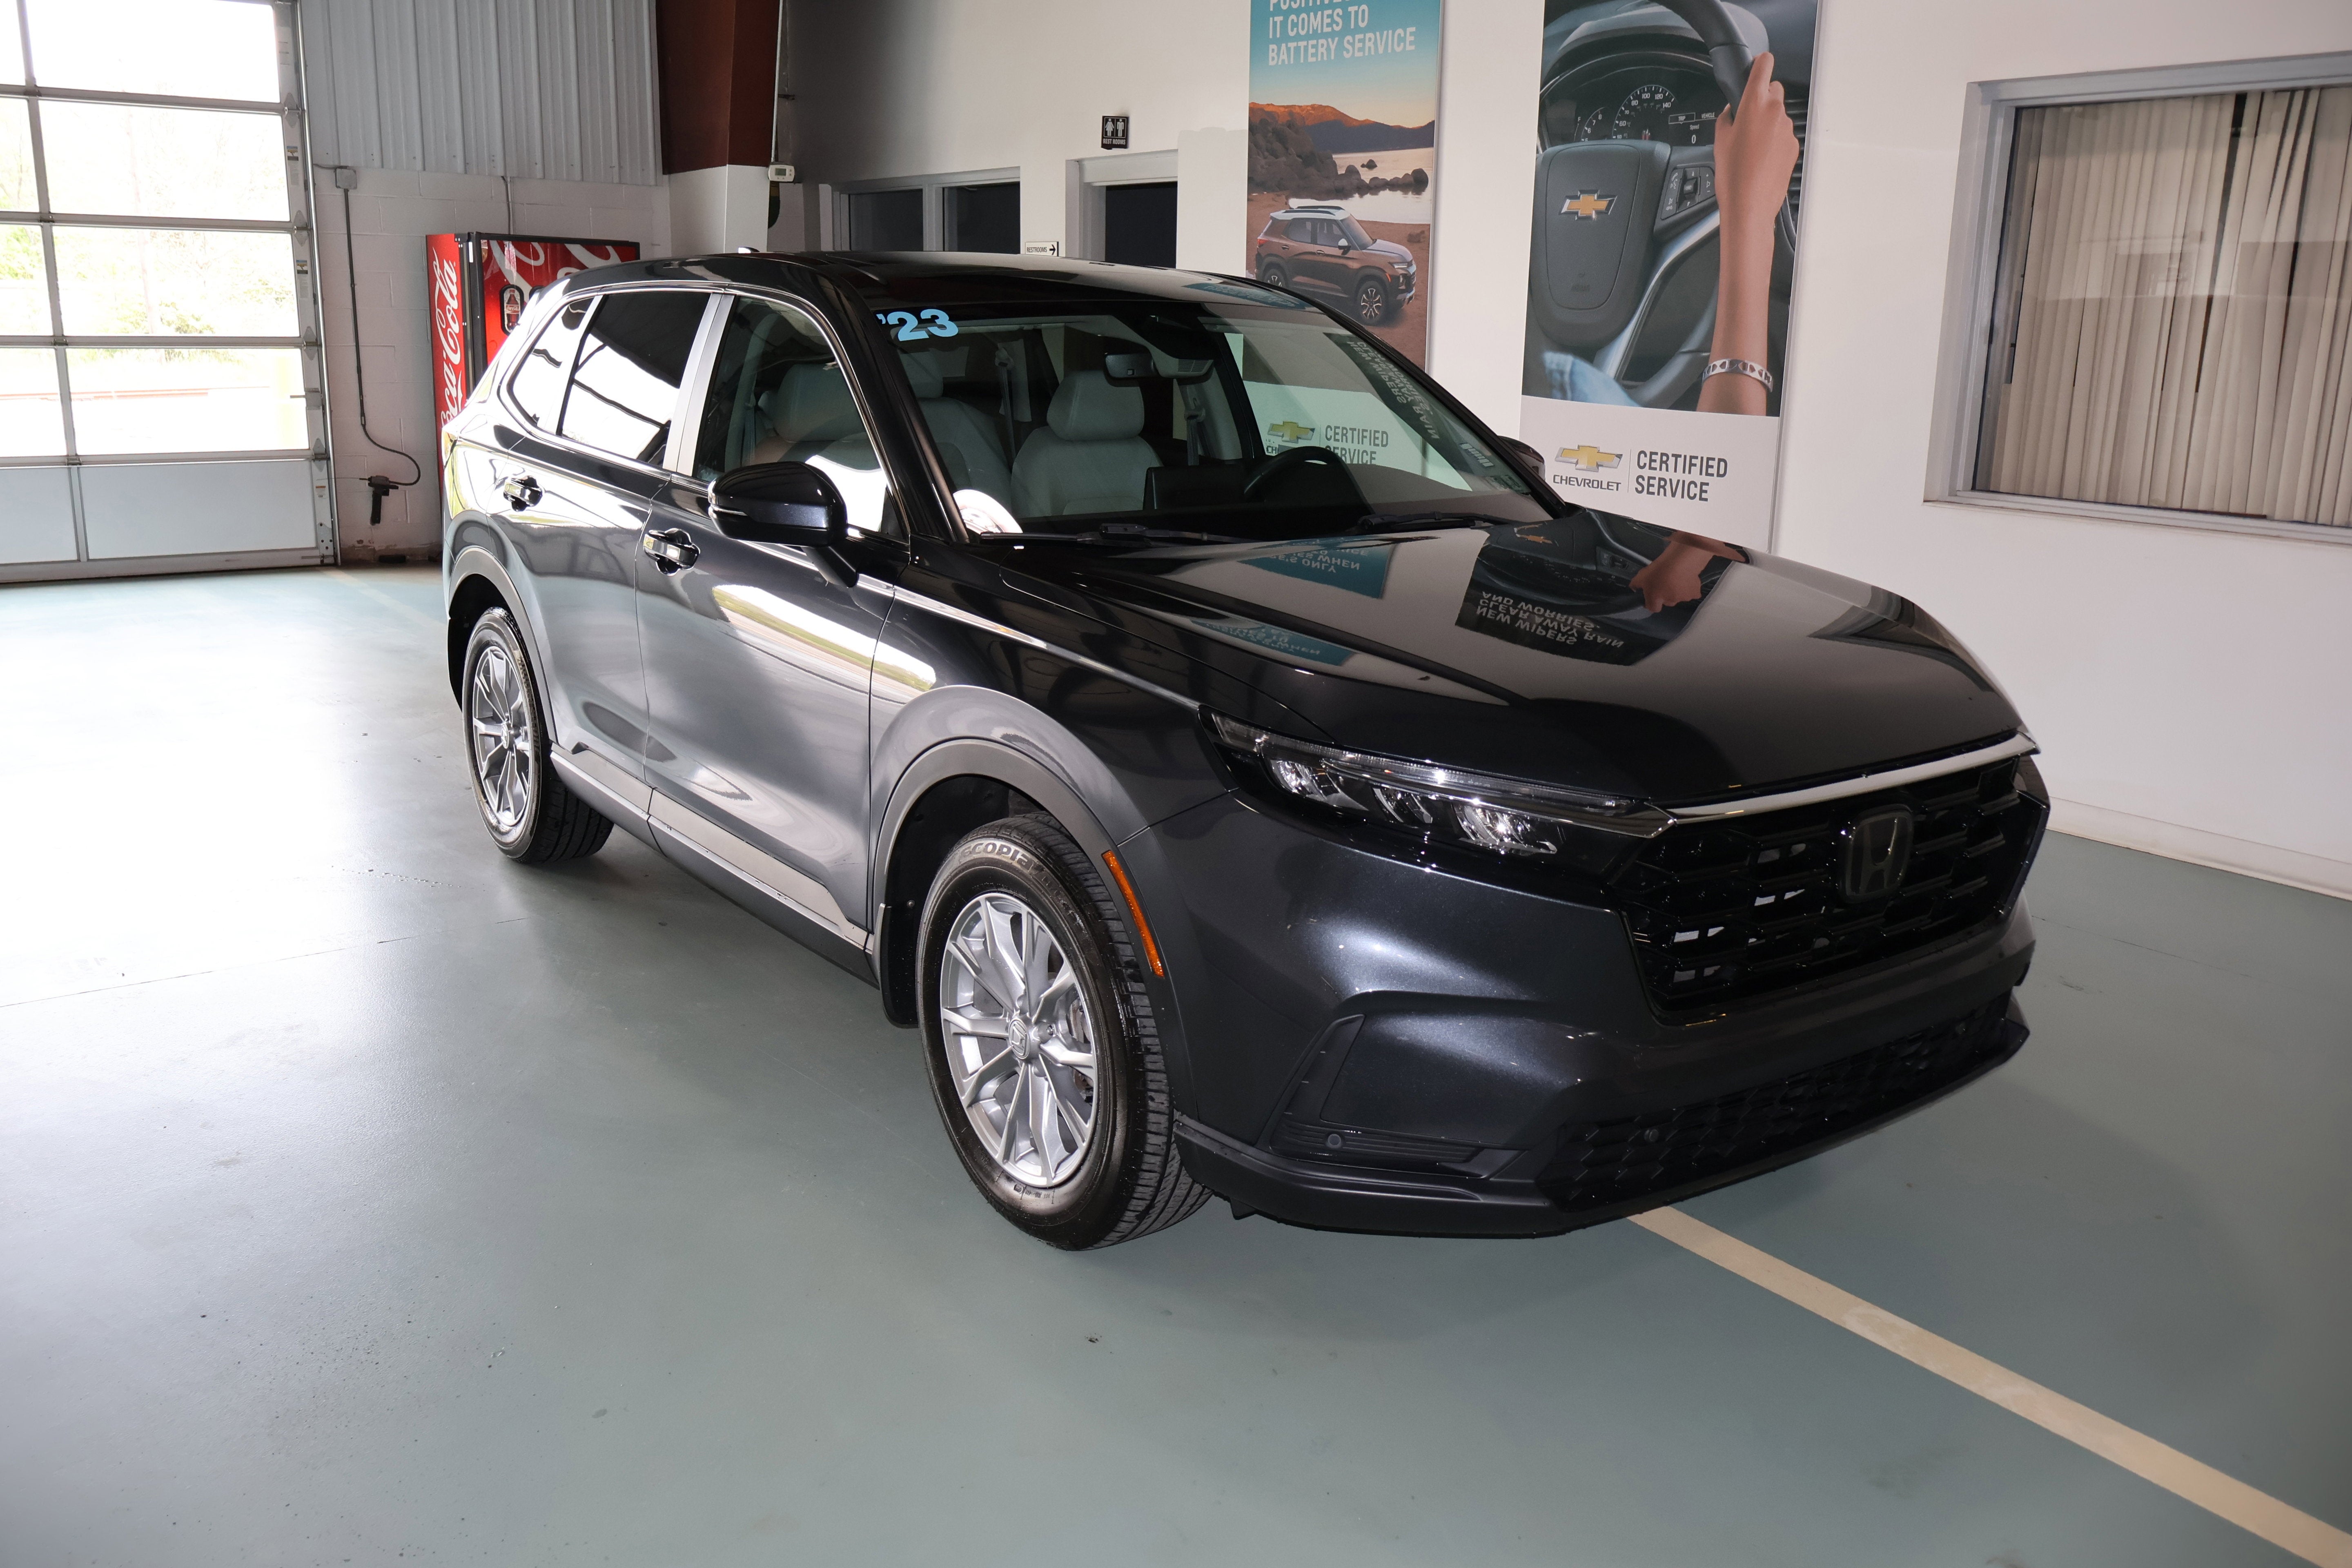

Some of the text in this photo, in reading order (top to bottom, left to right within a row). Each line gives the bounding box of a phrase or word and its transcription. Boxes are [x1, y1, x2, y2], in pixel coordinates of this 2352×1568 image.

[1269, 16, 1283, 38] IT
[1288, 8, 1343, 37] COMES
[1348, 4, 1368, 29] TO
[1269, 27, 1416, 66] BATTERY SERVICE
[1325, 425, 1389, 448] CERTIFIED
[1637, 450, 1728, 478] CERTIFIED
[1553, 474, 1621, 492] CHEVROLET
[1635, 475, 1710, 502] SERVICE
